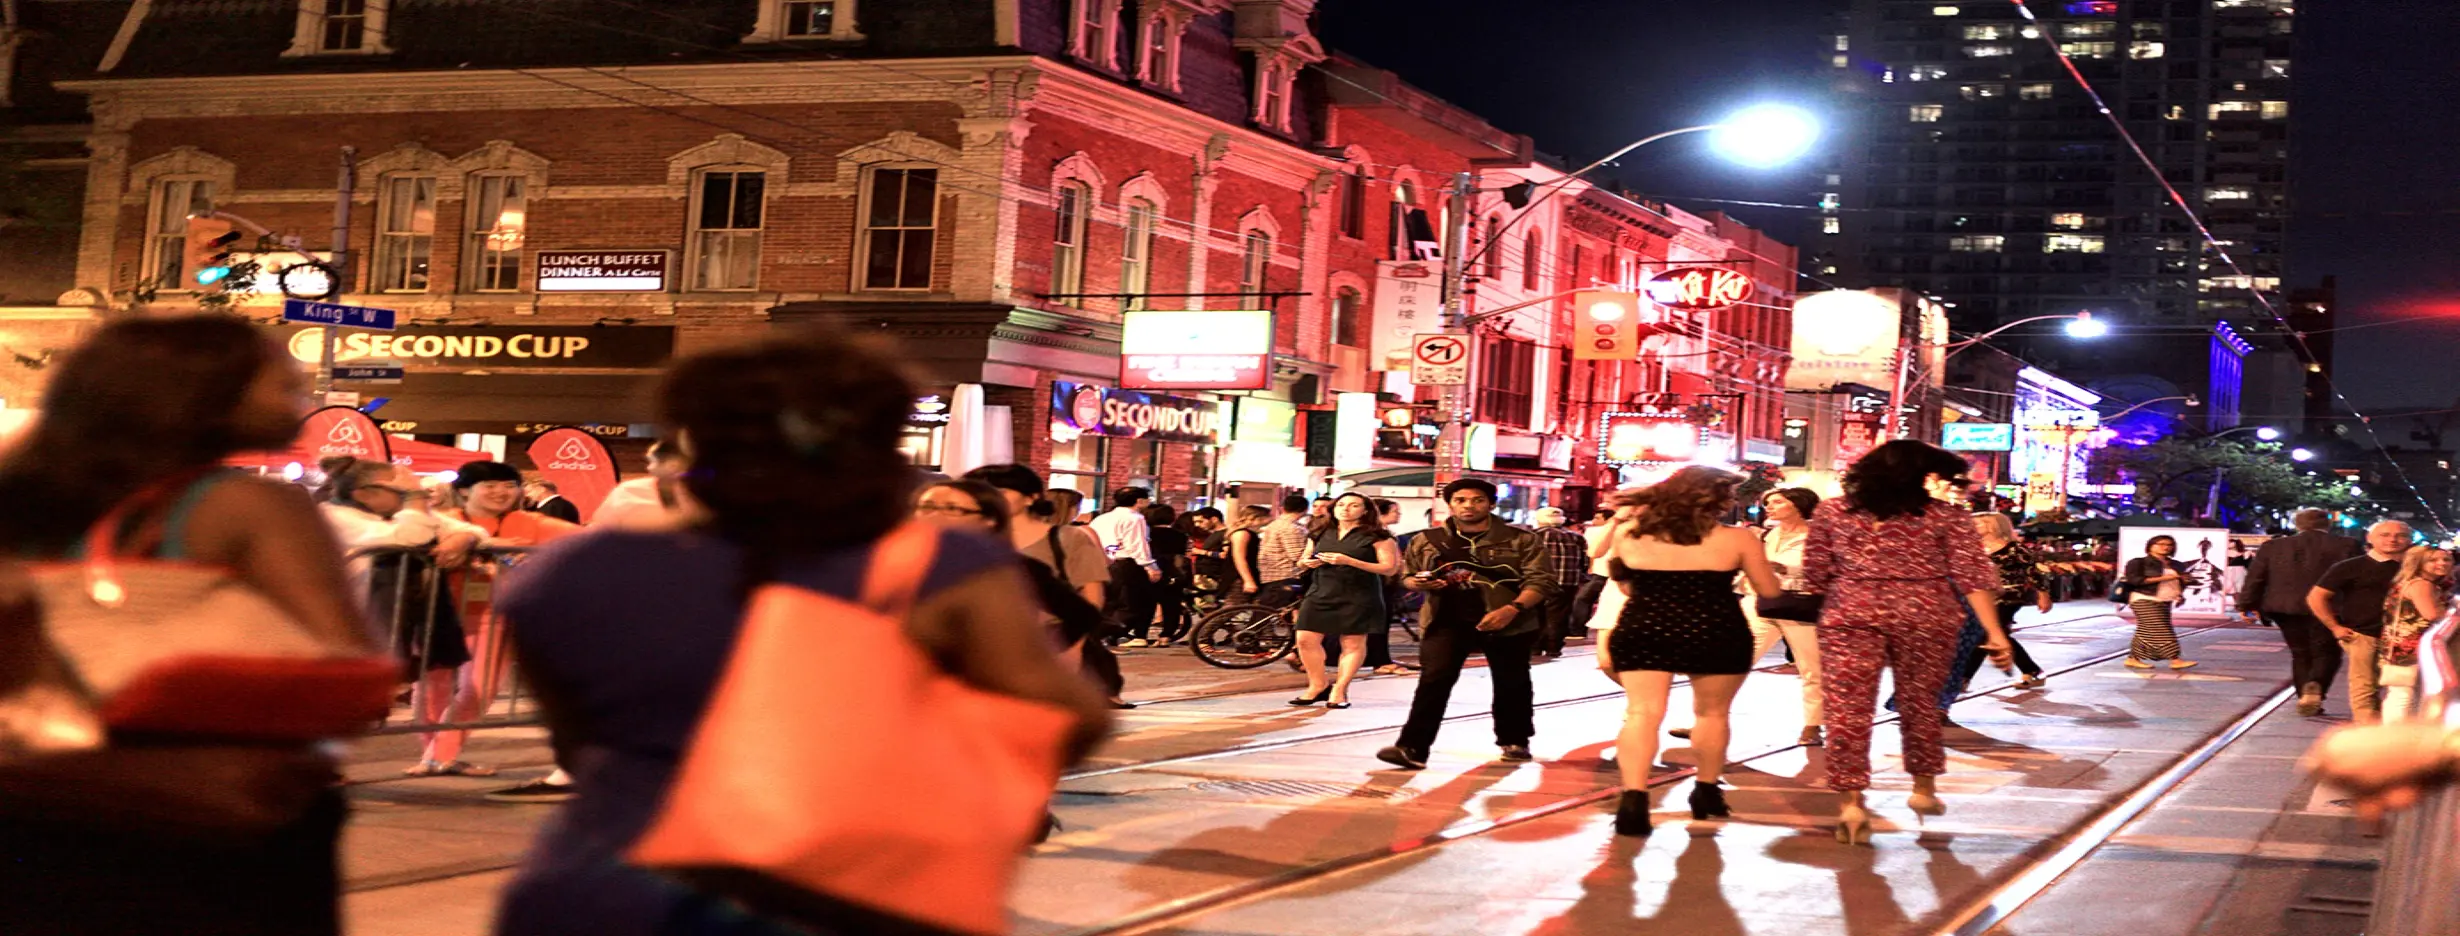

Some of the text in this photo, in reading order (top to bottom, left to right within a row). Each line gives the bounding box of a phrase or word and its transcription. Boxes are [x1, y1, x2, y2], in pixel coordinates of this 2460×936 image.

[541, 254, 662, 266] LUNCH BUFFET
[540, 267, 603, 277] DINNER
[303, 302, 344, 323] King
[362, 308, 377, 323] W
[345, 332, 589, 358] SECOND CUP
[1103, 398, 1179, 432] SECOND
[595, 425, 627, 436] CUP
